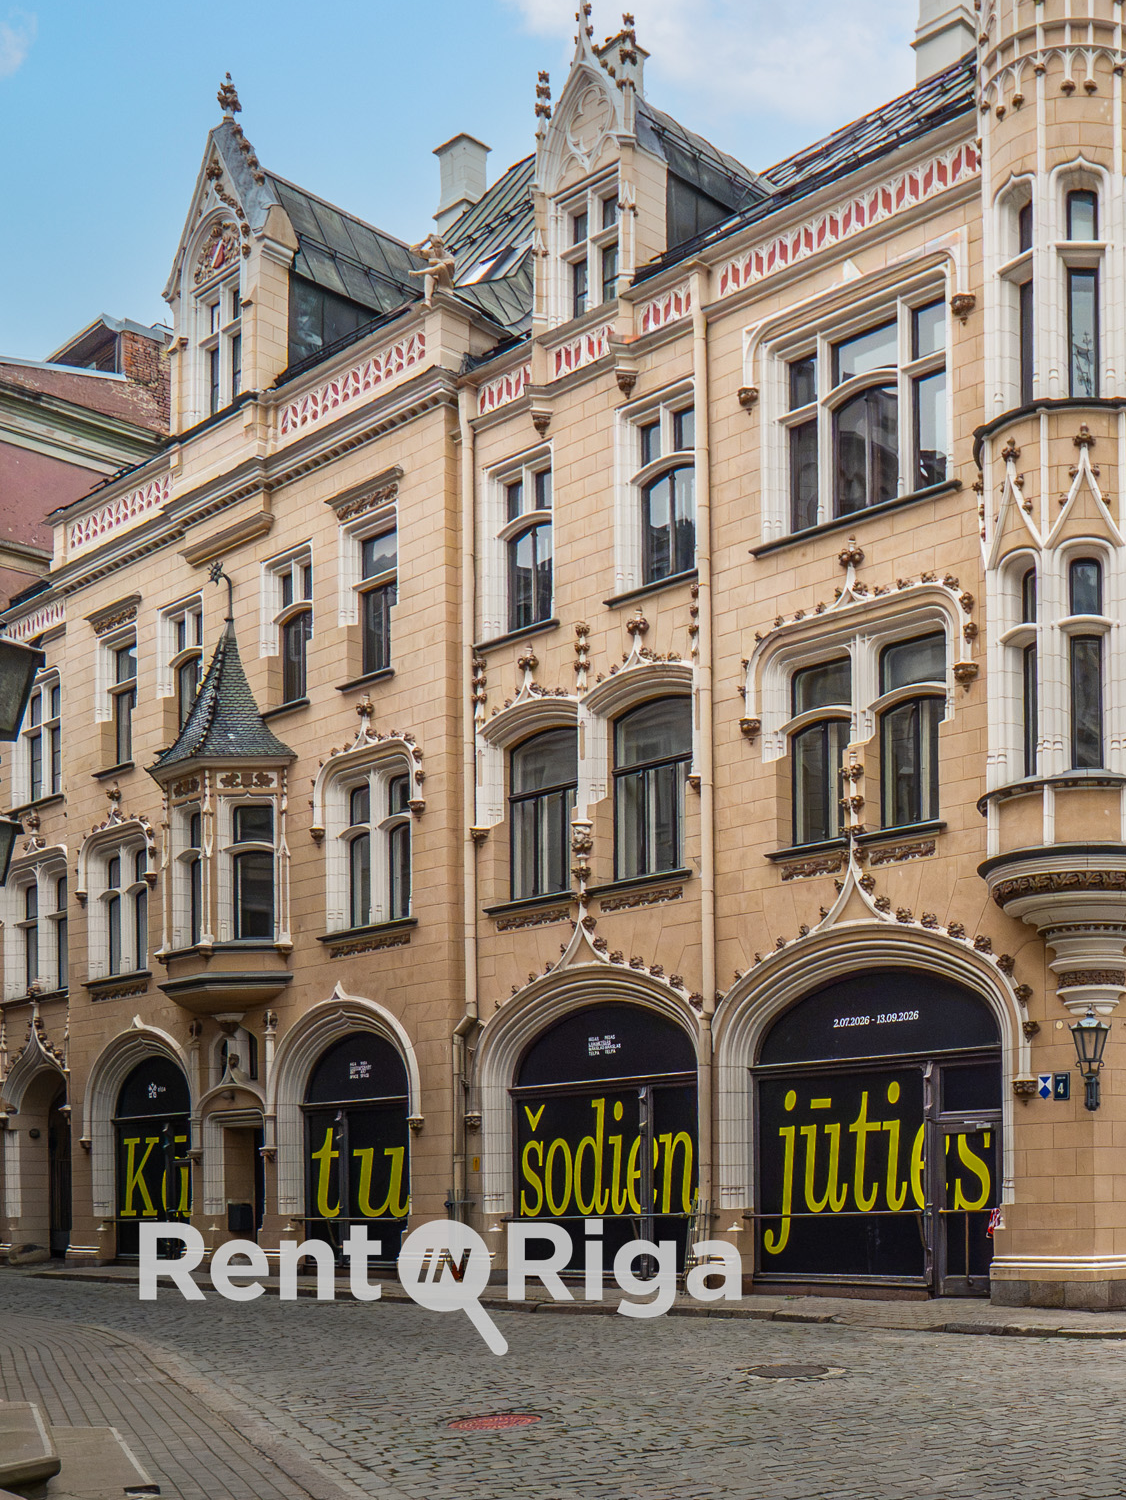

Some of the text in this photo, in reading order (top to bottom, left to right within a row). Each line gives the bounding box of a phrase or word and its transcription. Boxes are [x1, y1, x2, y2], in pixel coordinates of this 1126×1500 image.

[833, 1015, 870, 1028] 2.07.2026
[876, 1010, 919, 1024] 13.09.2026
[1057, 1082, 1065, 1095] 4
[312, 1127, 410, 1218] tu
[520, 1098, 699, 1217] šodien
